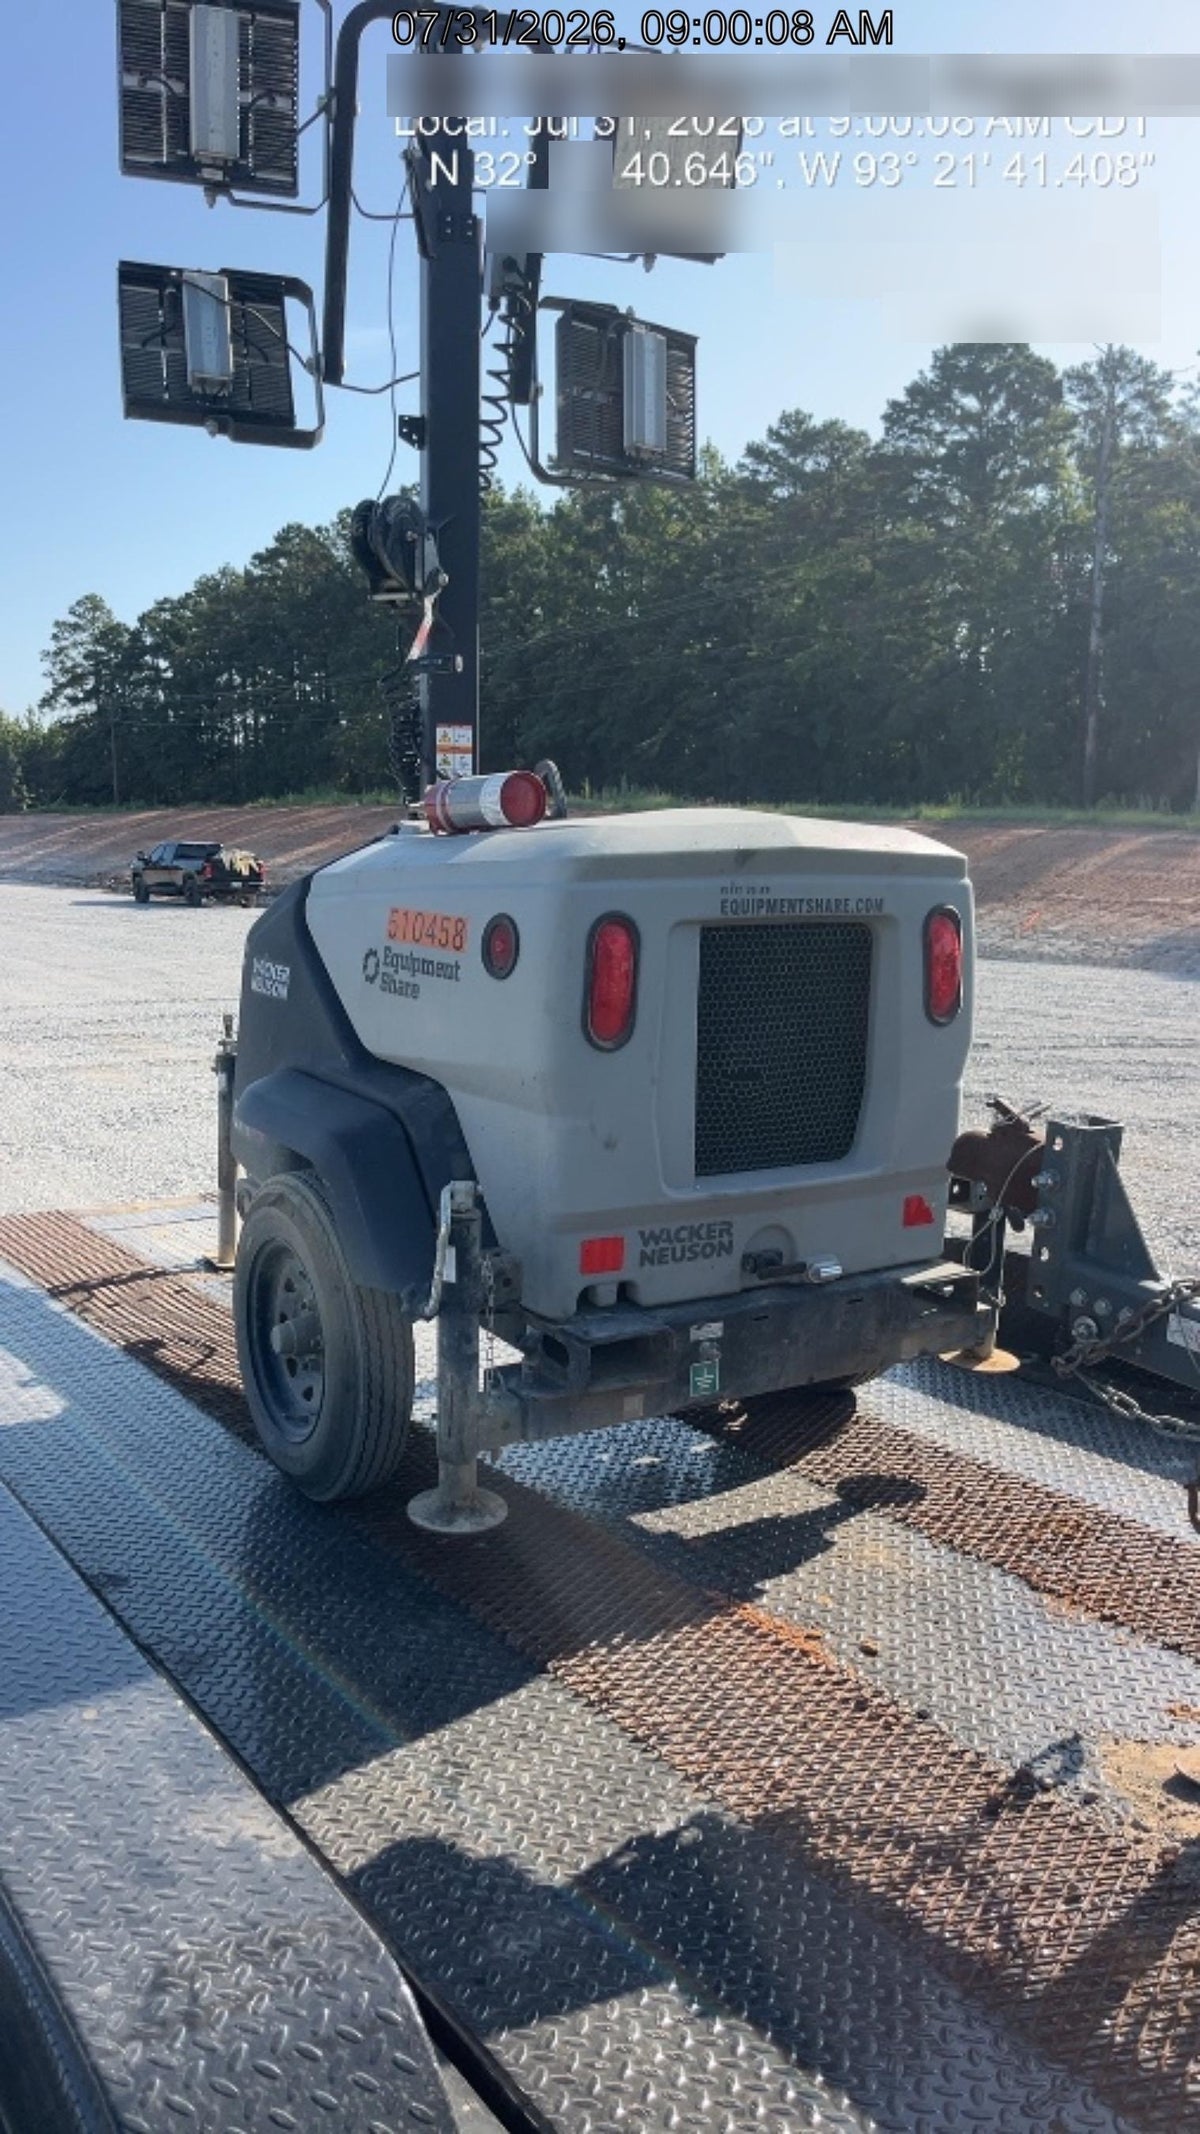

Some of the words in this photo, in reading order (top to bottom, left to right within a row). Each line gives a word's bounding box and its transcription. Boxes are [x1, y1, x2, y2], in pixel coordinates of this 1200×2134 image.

[720, 897, 884, 915] EQUIPMENTSHARE.COM
[387, 908, 466, 952] 510458
[382, 945, 461, 982] Equipment
[379, 971, 420, 1000] Share
[638, 1220, 734, 1248] WACKER
[639, 1240, 734, 1268] NEUSON
